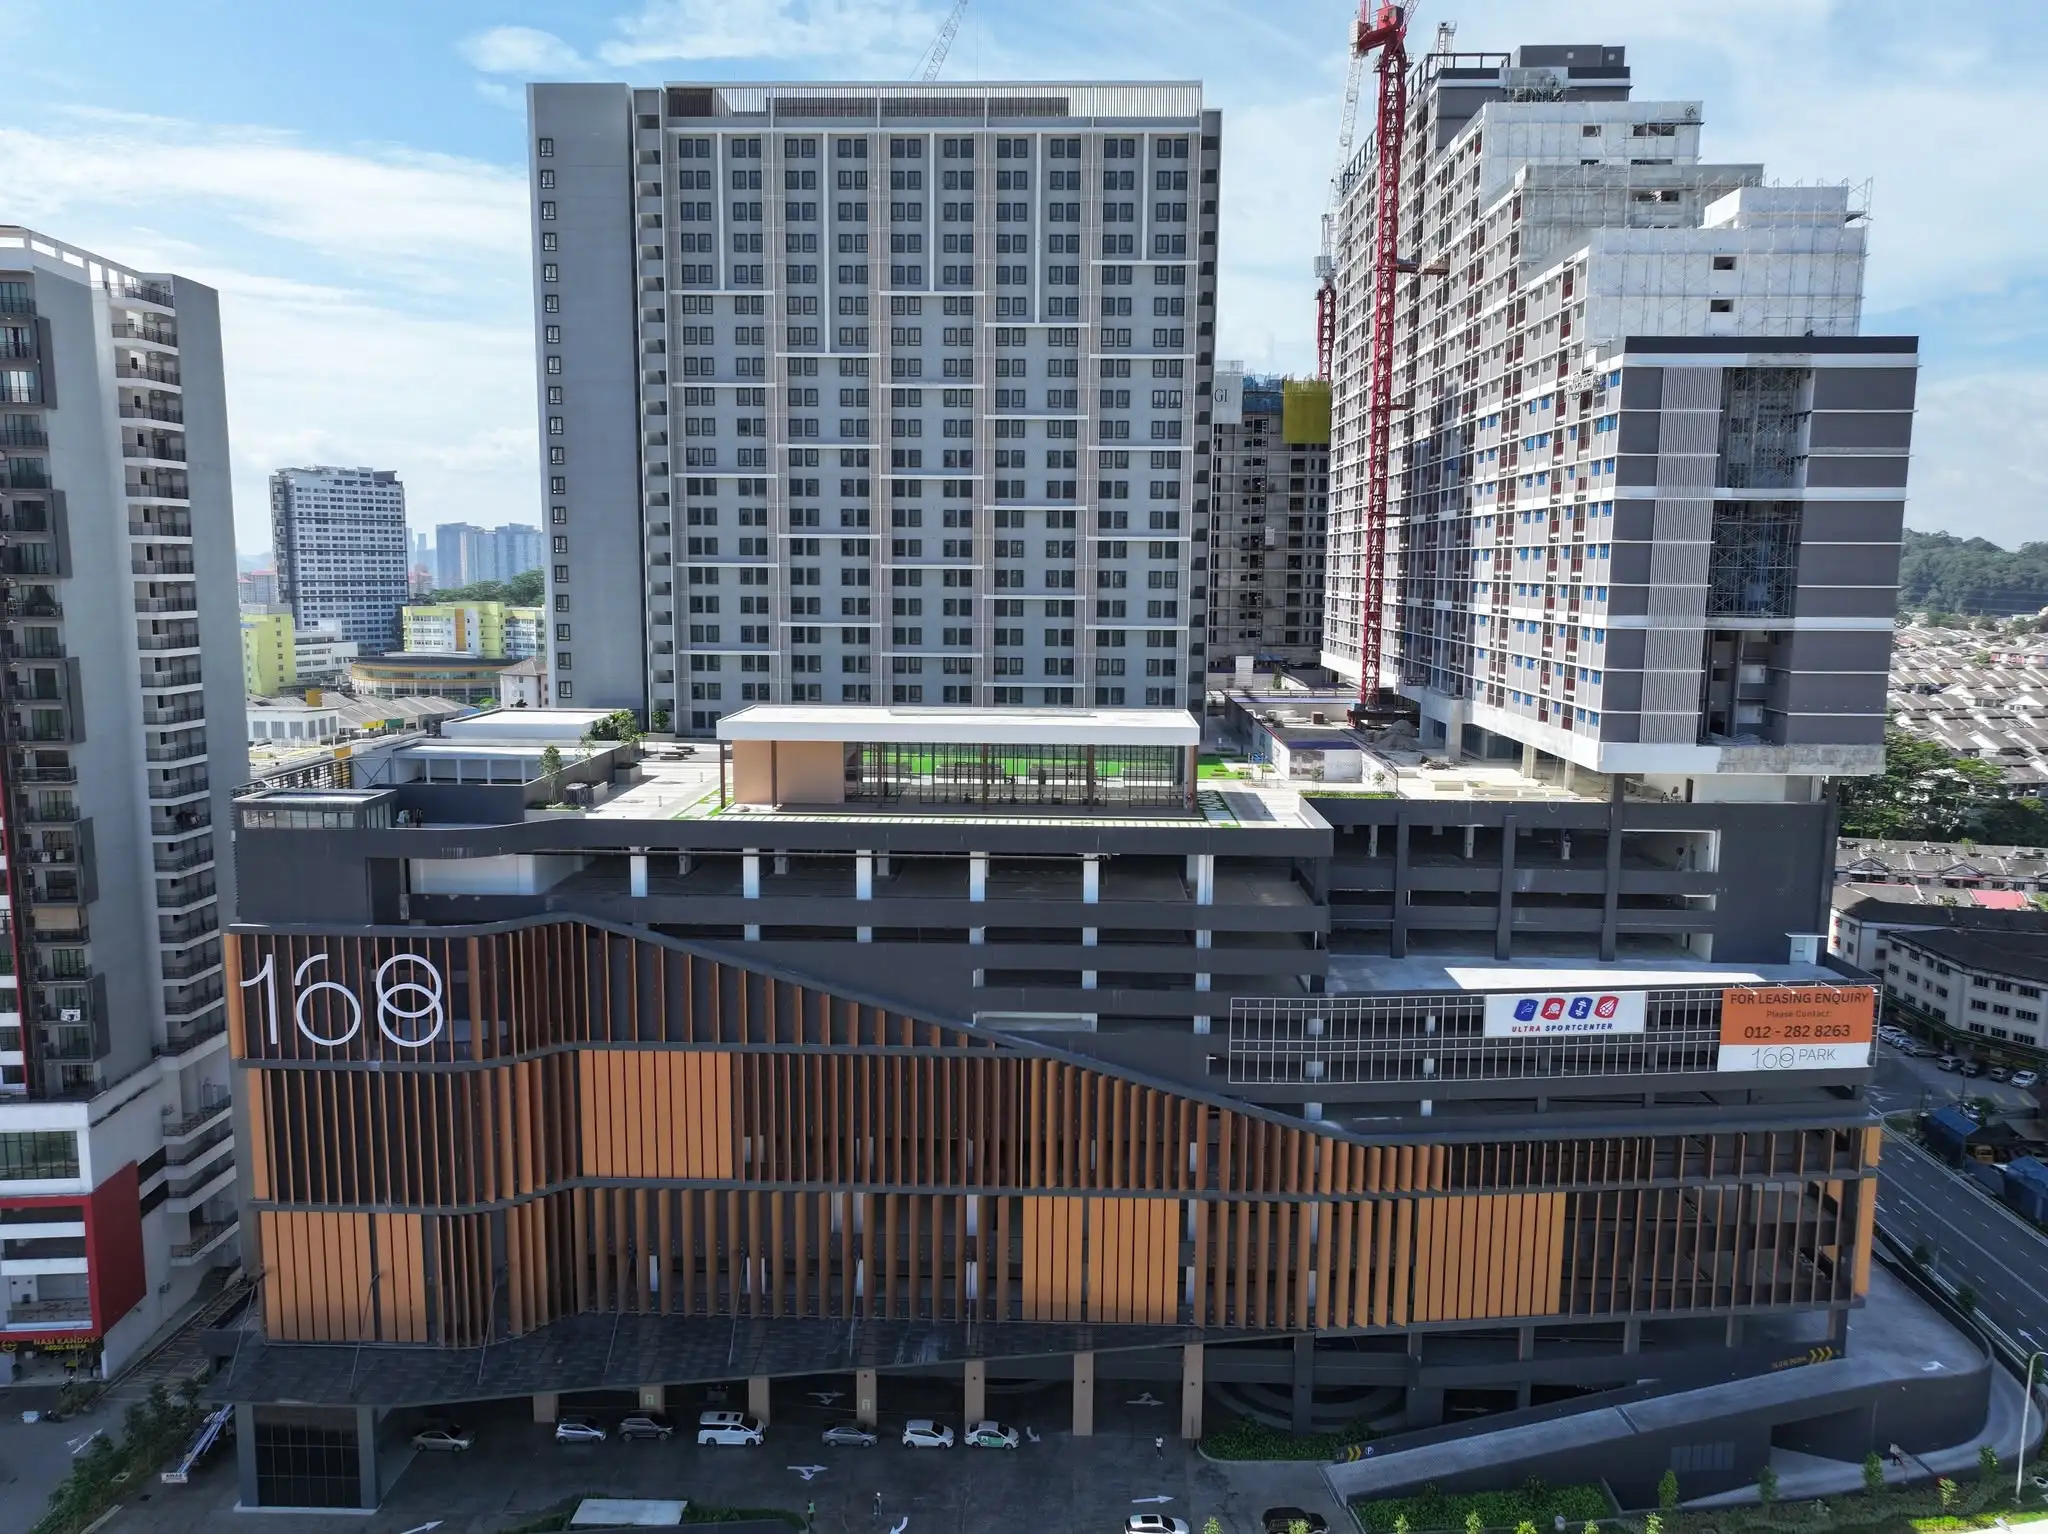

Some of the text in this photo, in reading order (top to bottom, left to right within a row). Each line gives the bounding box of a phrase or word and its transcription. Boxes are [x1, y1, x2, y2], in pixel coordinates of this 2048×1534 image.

[240, 953, 443, 1047] 168
[1730, 992, 1868, 1005] FOR LEASING ENQUIRY
[1766, 1010, 1794, 1018] Please
[1545, 1023, 1613, 1031] SPORTCENTER
[1744, 1026, 1772, 1039] 012
[1783, 1025, 1811, 1038] 282
[1814, 1024, 1851, 1038] 8263
[1751, 1046, 1837, 1069] 168 PARK
